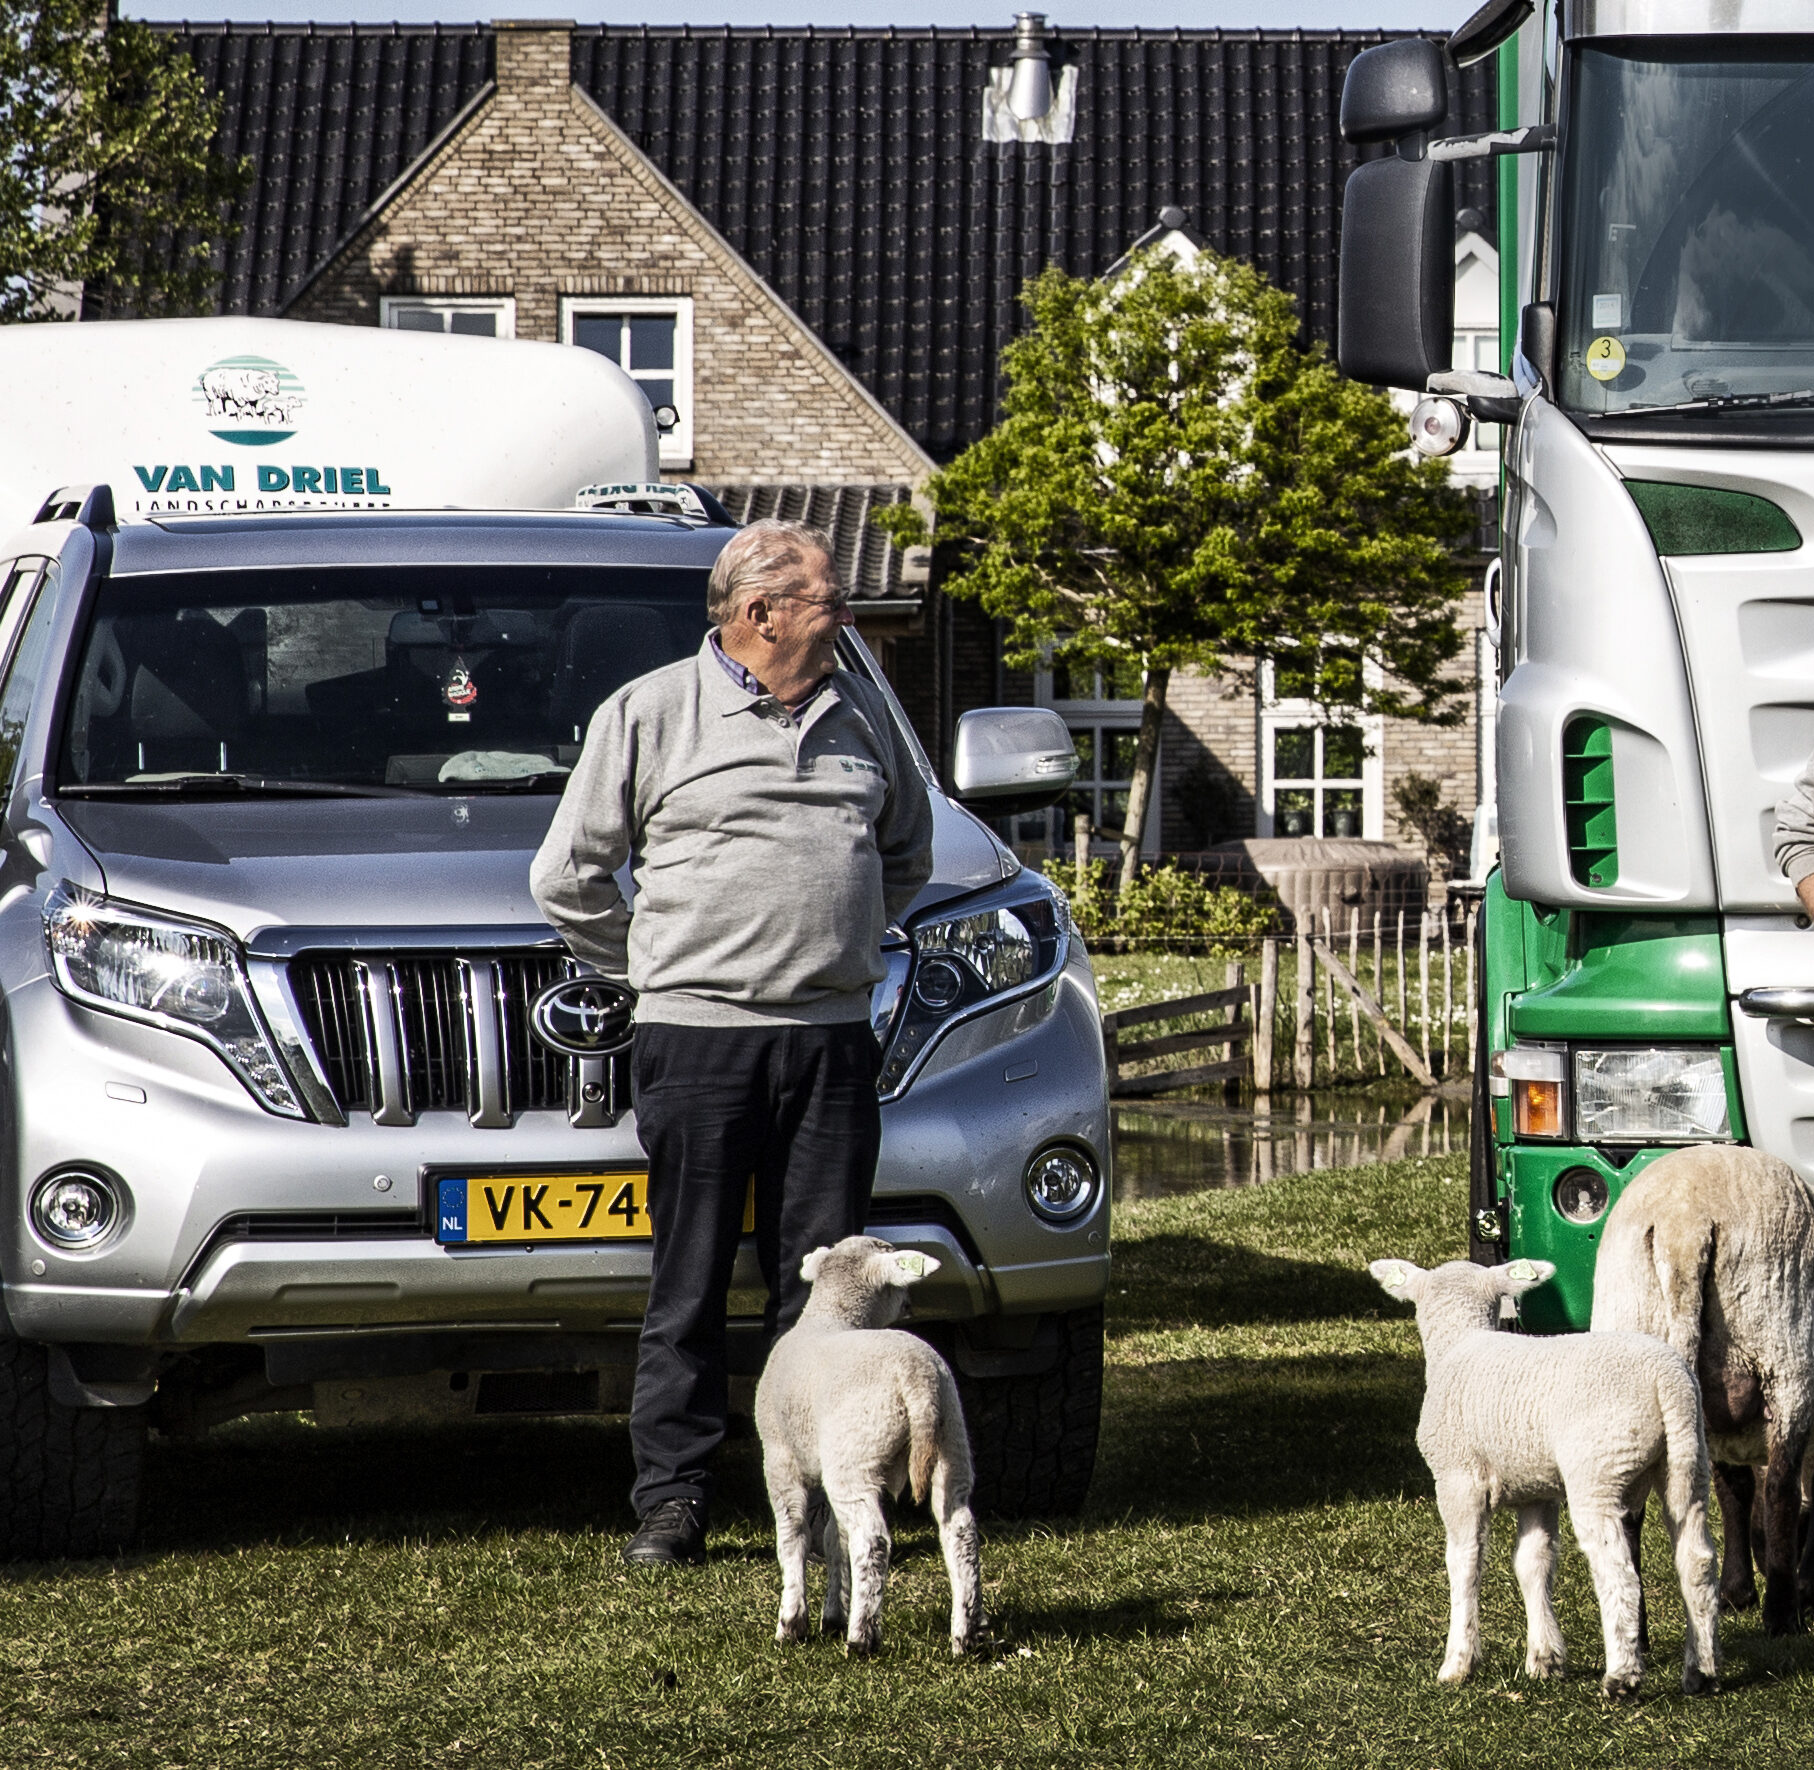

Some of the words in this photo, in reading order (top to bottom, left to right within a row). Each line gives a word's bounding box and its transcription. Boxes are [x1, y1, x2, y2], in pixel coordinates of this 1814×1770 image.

[1600, 339, 1611, 358] 3
[133, 465, 235, 493] VAN
[257, 465, 391, 495] DRIEL
[484, 1182, 649, 1231] VK-74
[442, 1216, 463, 1231] NL
